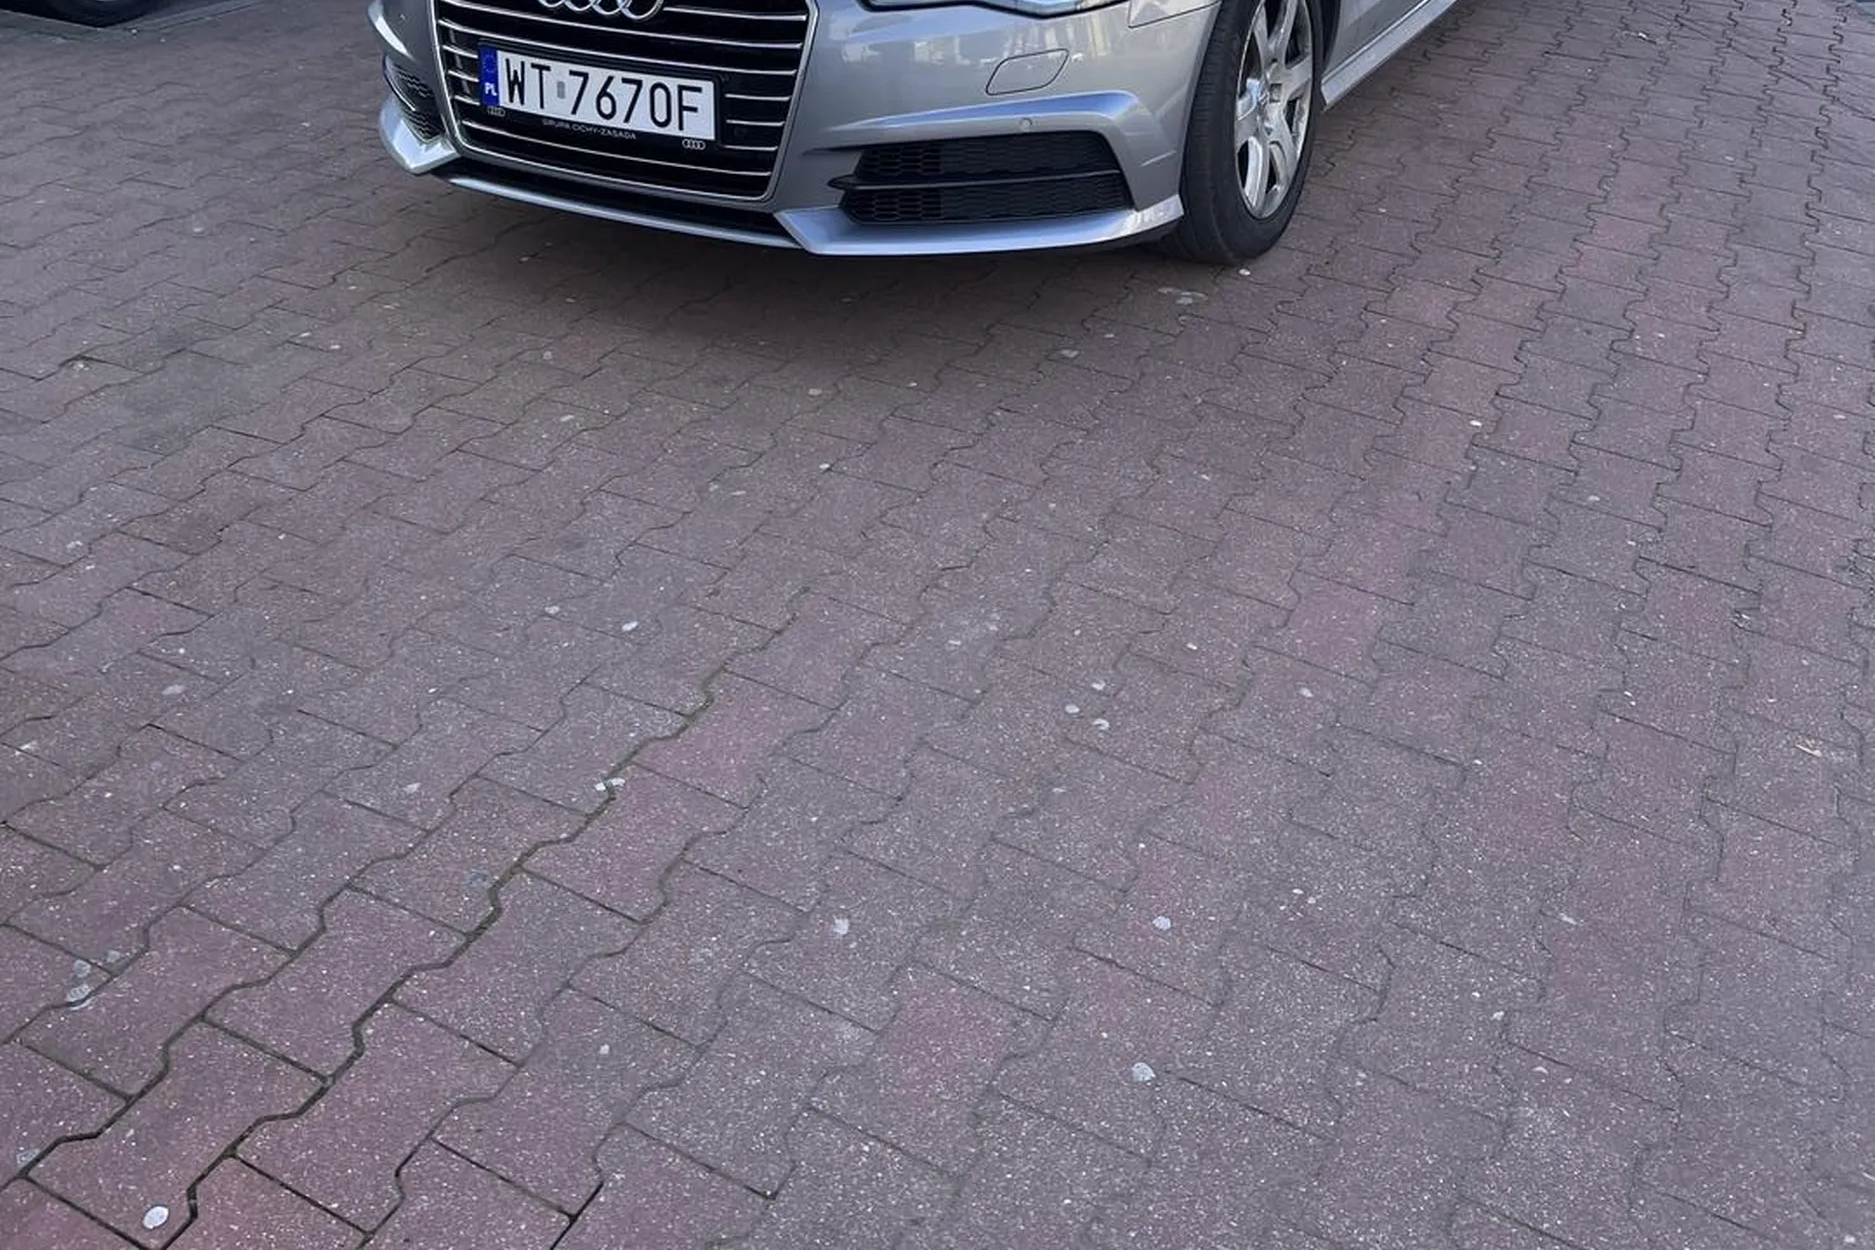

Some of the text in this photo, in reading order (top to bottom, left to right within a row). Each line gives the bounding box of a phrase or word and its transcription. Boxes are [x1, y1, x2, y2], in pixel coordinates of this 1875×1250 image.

[484, 81, 498, 96] PL
[505, 57, 703, 131] WT 7670F
